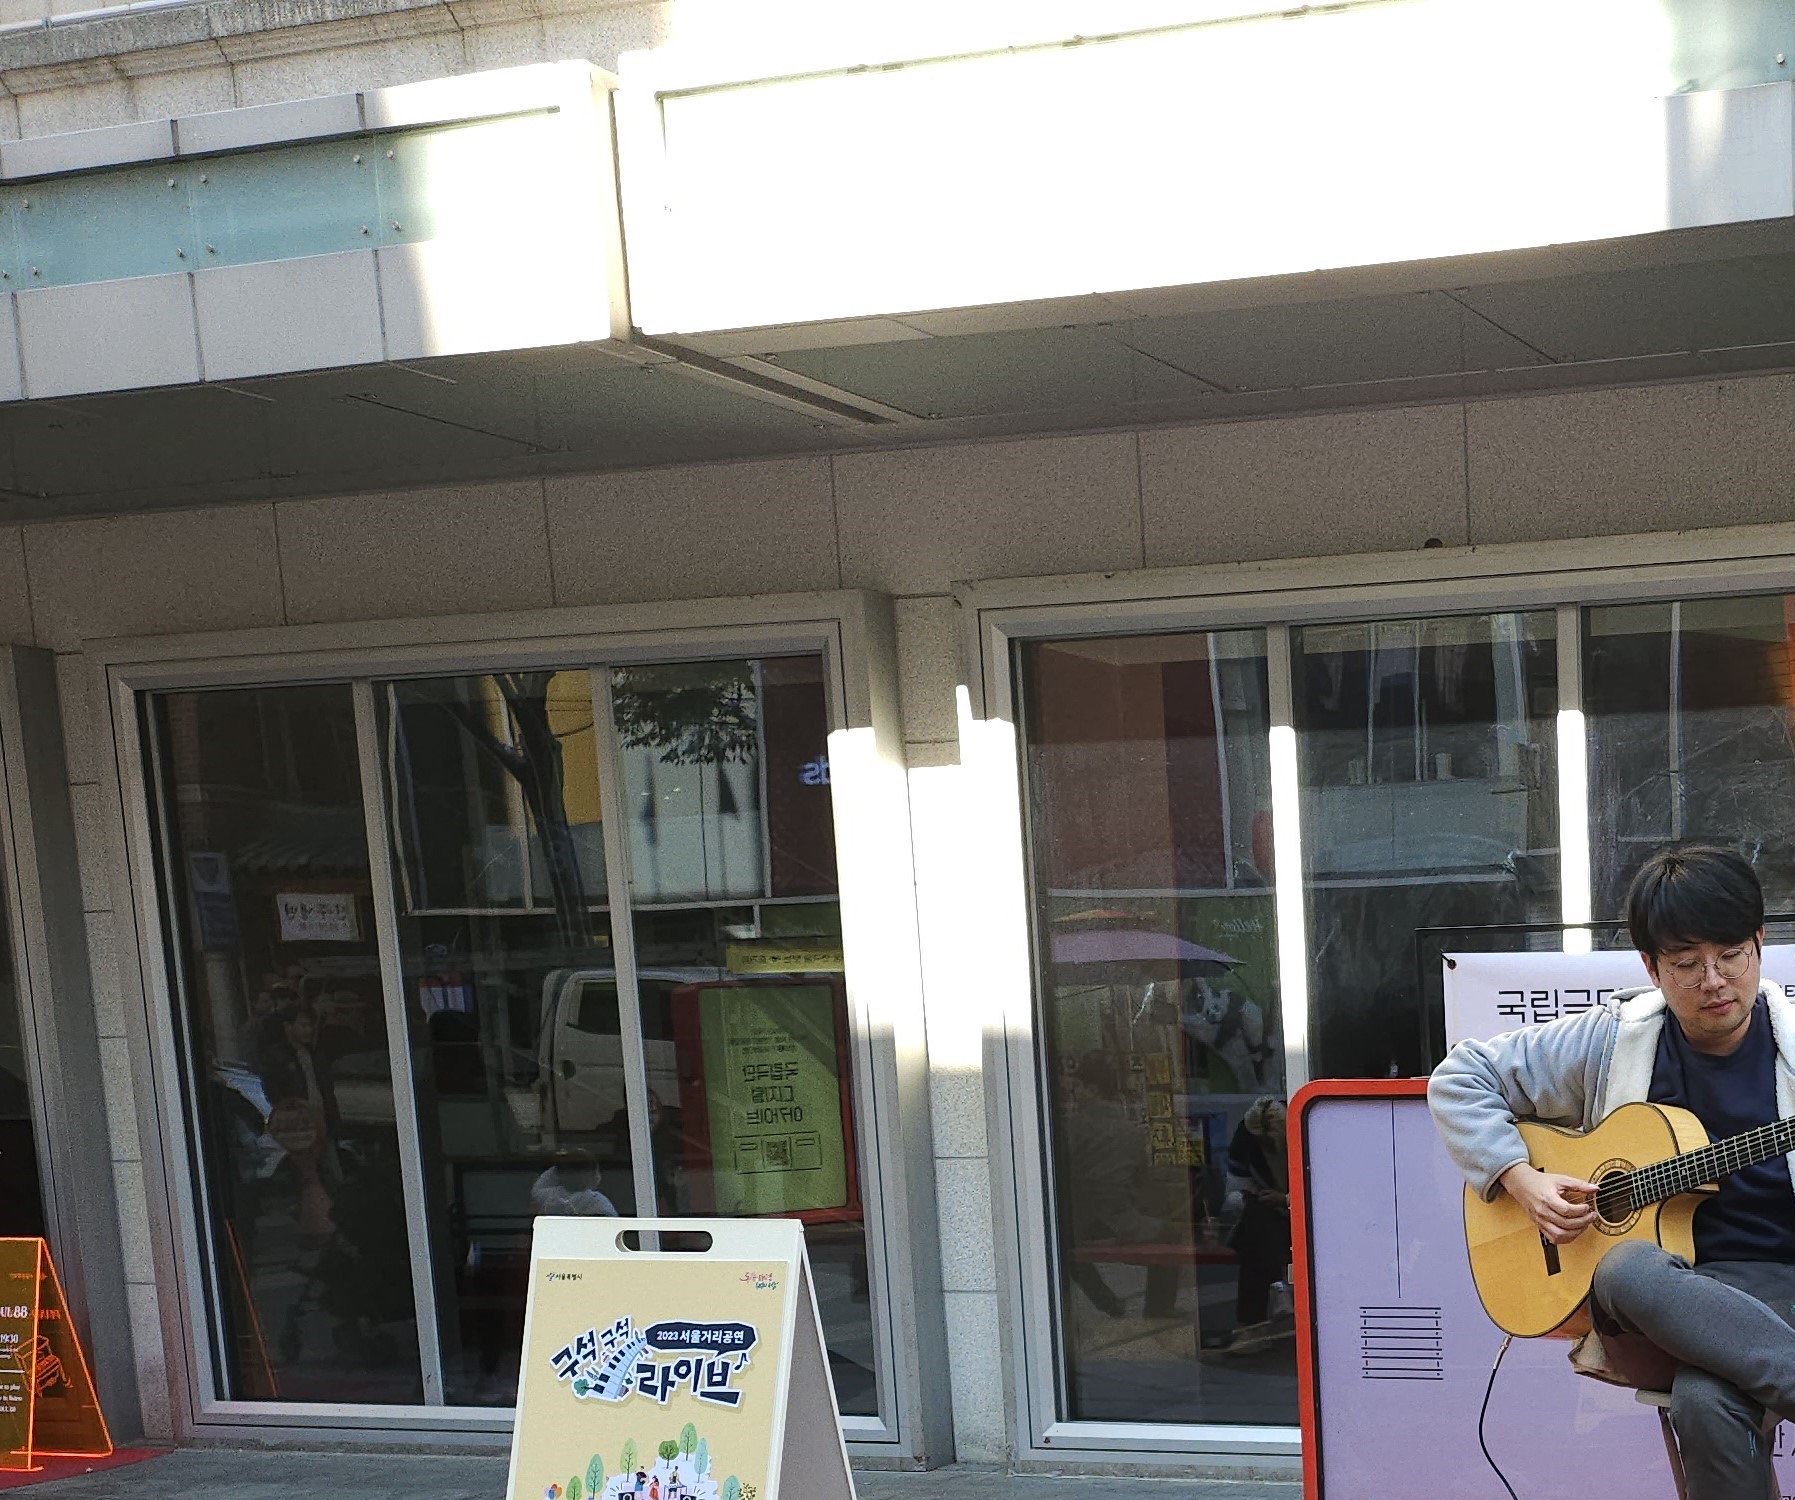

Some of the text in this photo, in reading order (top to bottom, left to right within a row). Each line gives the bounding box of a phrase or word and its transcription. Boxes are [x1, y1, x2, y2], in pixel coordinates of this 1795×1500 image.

[1497, 988, 1624, 1024] 국립극
[551, 1317, 630, 1378] 구석 구석
[656, 1330, 745, 1344] 2023 서울거리공연
[636, 1358, 742, 1405] 라이브
